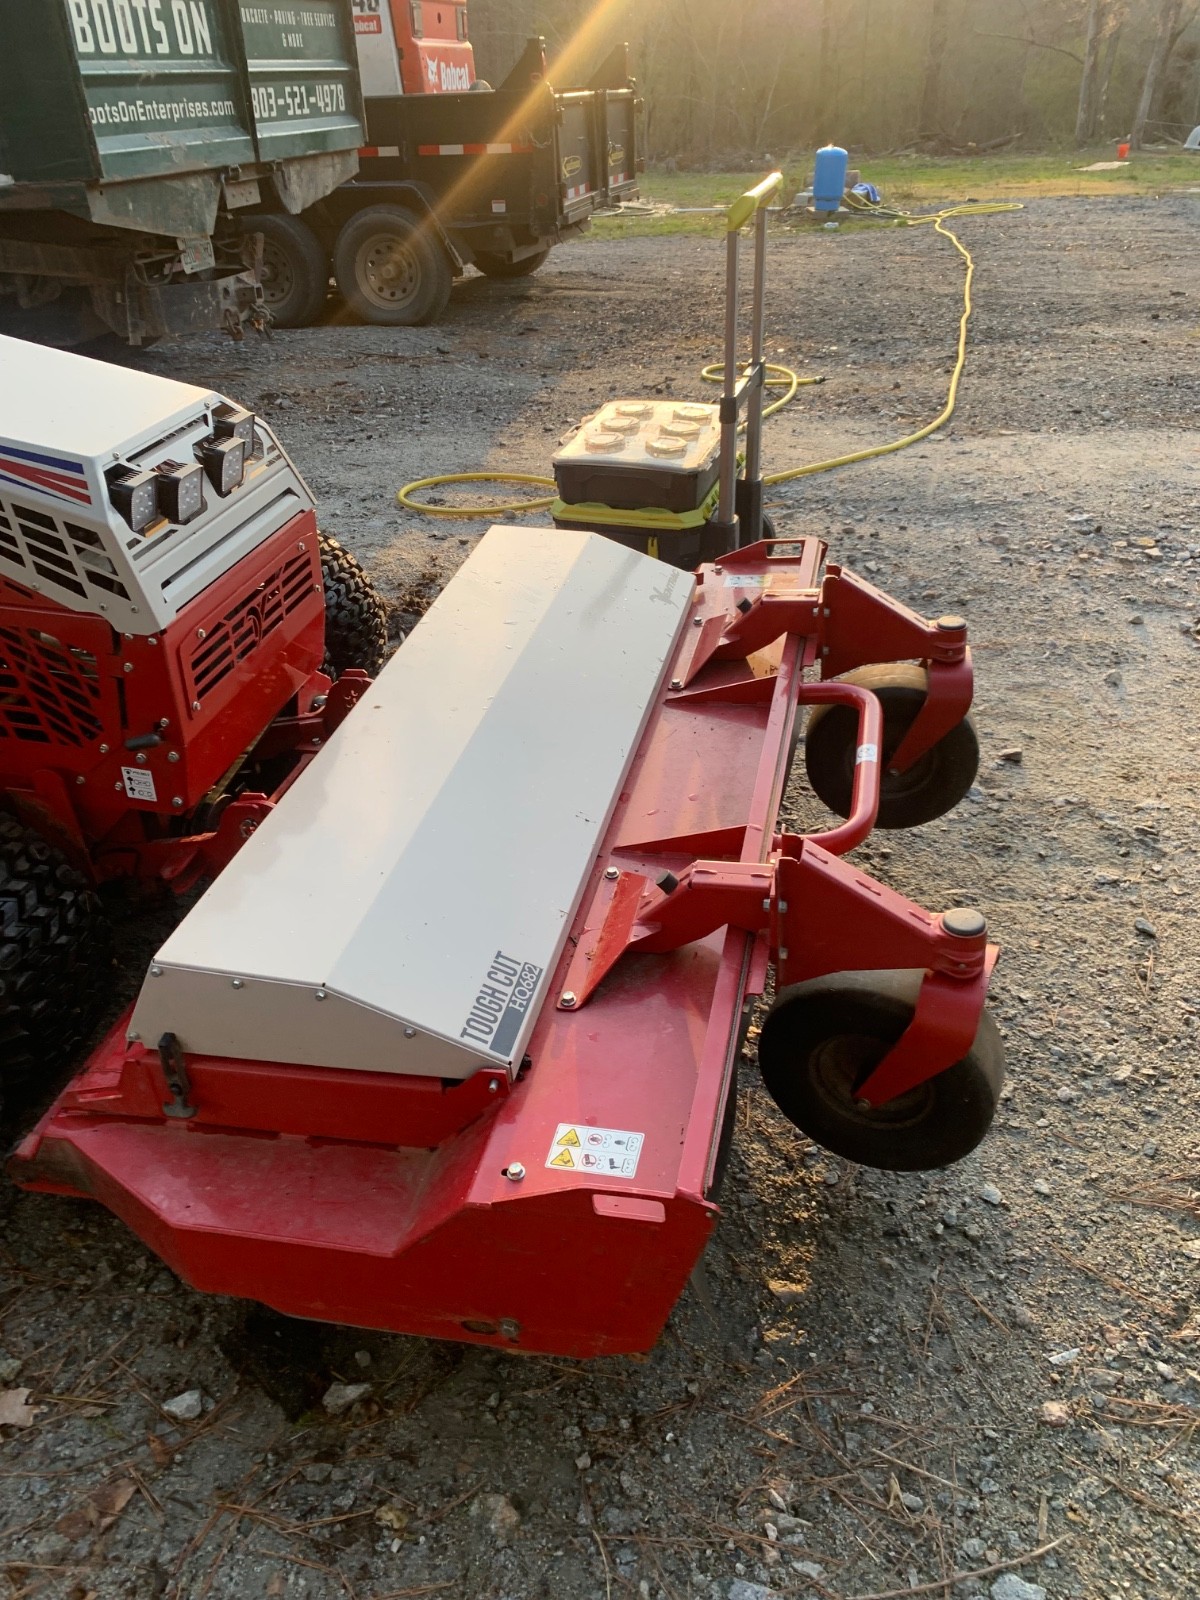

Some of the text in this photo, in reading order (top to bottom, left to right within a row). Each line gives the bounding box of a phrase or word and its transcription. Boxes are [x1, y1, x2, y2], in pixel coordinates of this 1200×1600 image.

[68, 0, 213, 55] BOOTS ON
[273, 9, 296, 26] PAVING
[300, 11, 314, 26] TREE
[314, 12, 336, 28] SERVICE
[287, 32, 304, 48] MORE
[440, 61, 470, 91] Bobcat
[251, 83, 346, 119] 803-521-4978
[460, 950, 522, 1045] TOUGH CUT
[508, 963, 540, 1013] HQ682
